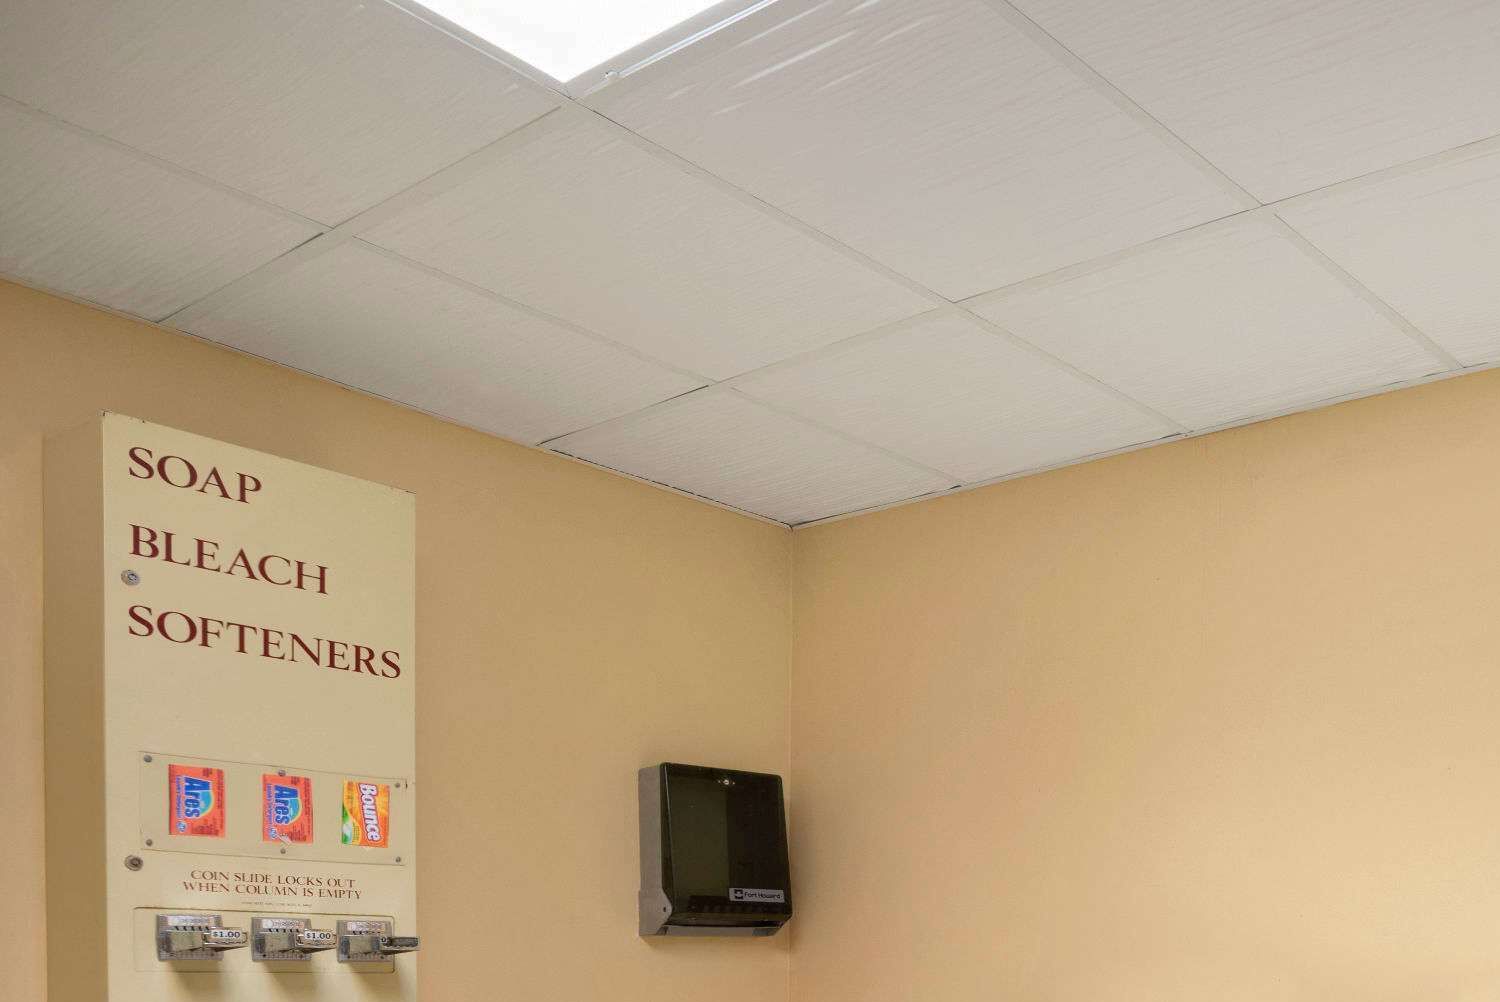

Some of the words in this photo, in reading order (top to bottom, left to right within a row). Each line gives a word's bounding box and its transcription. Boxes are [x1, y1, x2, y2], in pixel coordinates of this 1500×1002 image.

[128, 446, 263, 504] SOAP
[128, 523, 329, 595] BLEACH
[128, 605, 402, 679] SOFTENERS
[359, 783, 381, 842] Bounce
[183, 881, 230, 893] WHEN
[235, 884, 297, 897] COLUMN
[303, 888, 314, 897] IS
[318, 889, 362, 900] EMPTY
[190, 870, 230, 881] COIN
[234, 872, 273, 884] SLIDE
[278, 875, 323, 887] LOCKS
[327, 878, 356, 888] OUT
[213, 930, 241, 939] $1.00
[306, 931, 332, 940] $1.00
